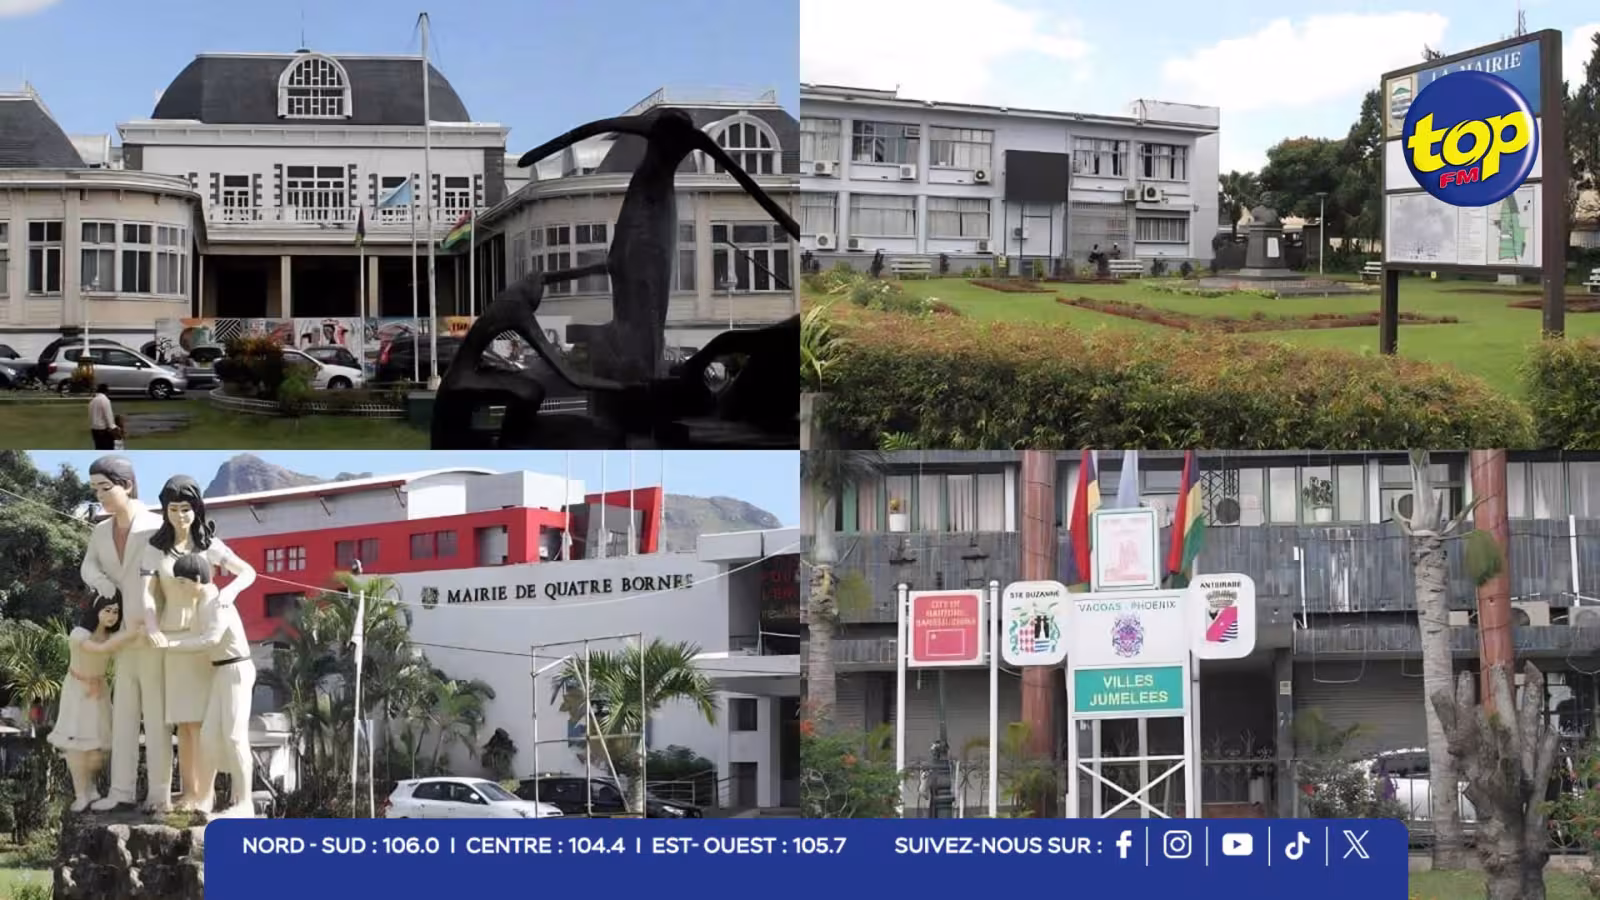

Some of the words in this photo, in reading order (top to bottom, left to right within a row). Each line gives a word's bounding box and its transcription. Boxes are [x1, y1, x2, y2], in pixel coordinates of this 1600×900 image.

[447, 586, 508, 604] MAIRIE
[516, 583, 537, 600] DE
[544, 578, 612, 601] QUATRE
[621, 574, 693, 593] BORNES
[1078, 601, 1122, 613] VACOAS
[1130, 600, 1176, 611] PHOENIX
[1103, 674, 1154, 689] VILLES
[1089, 690, 1168, 707] JUMELEES
